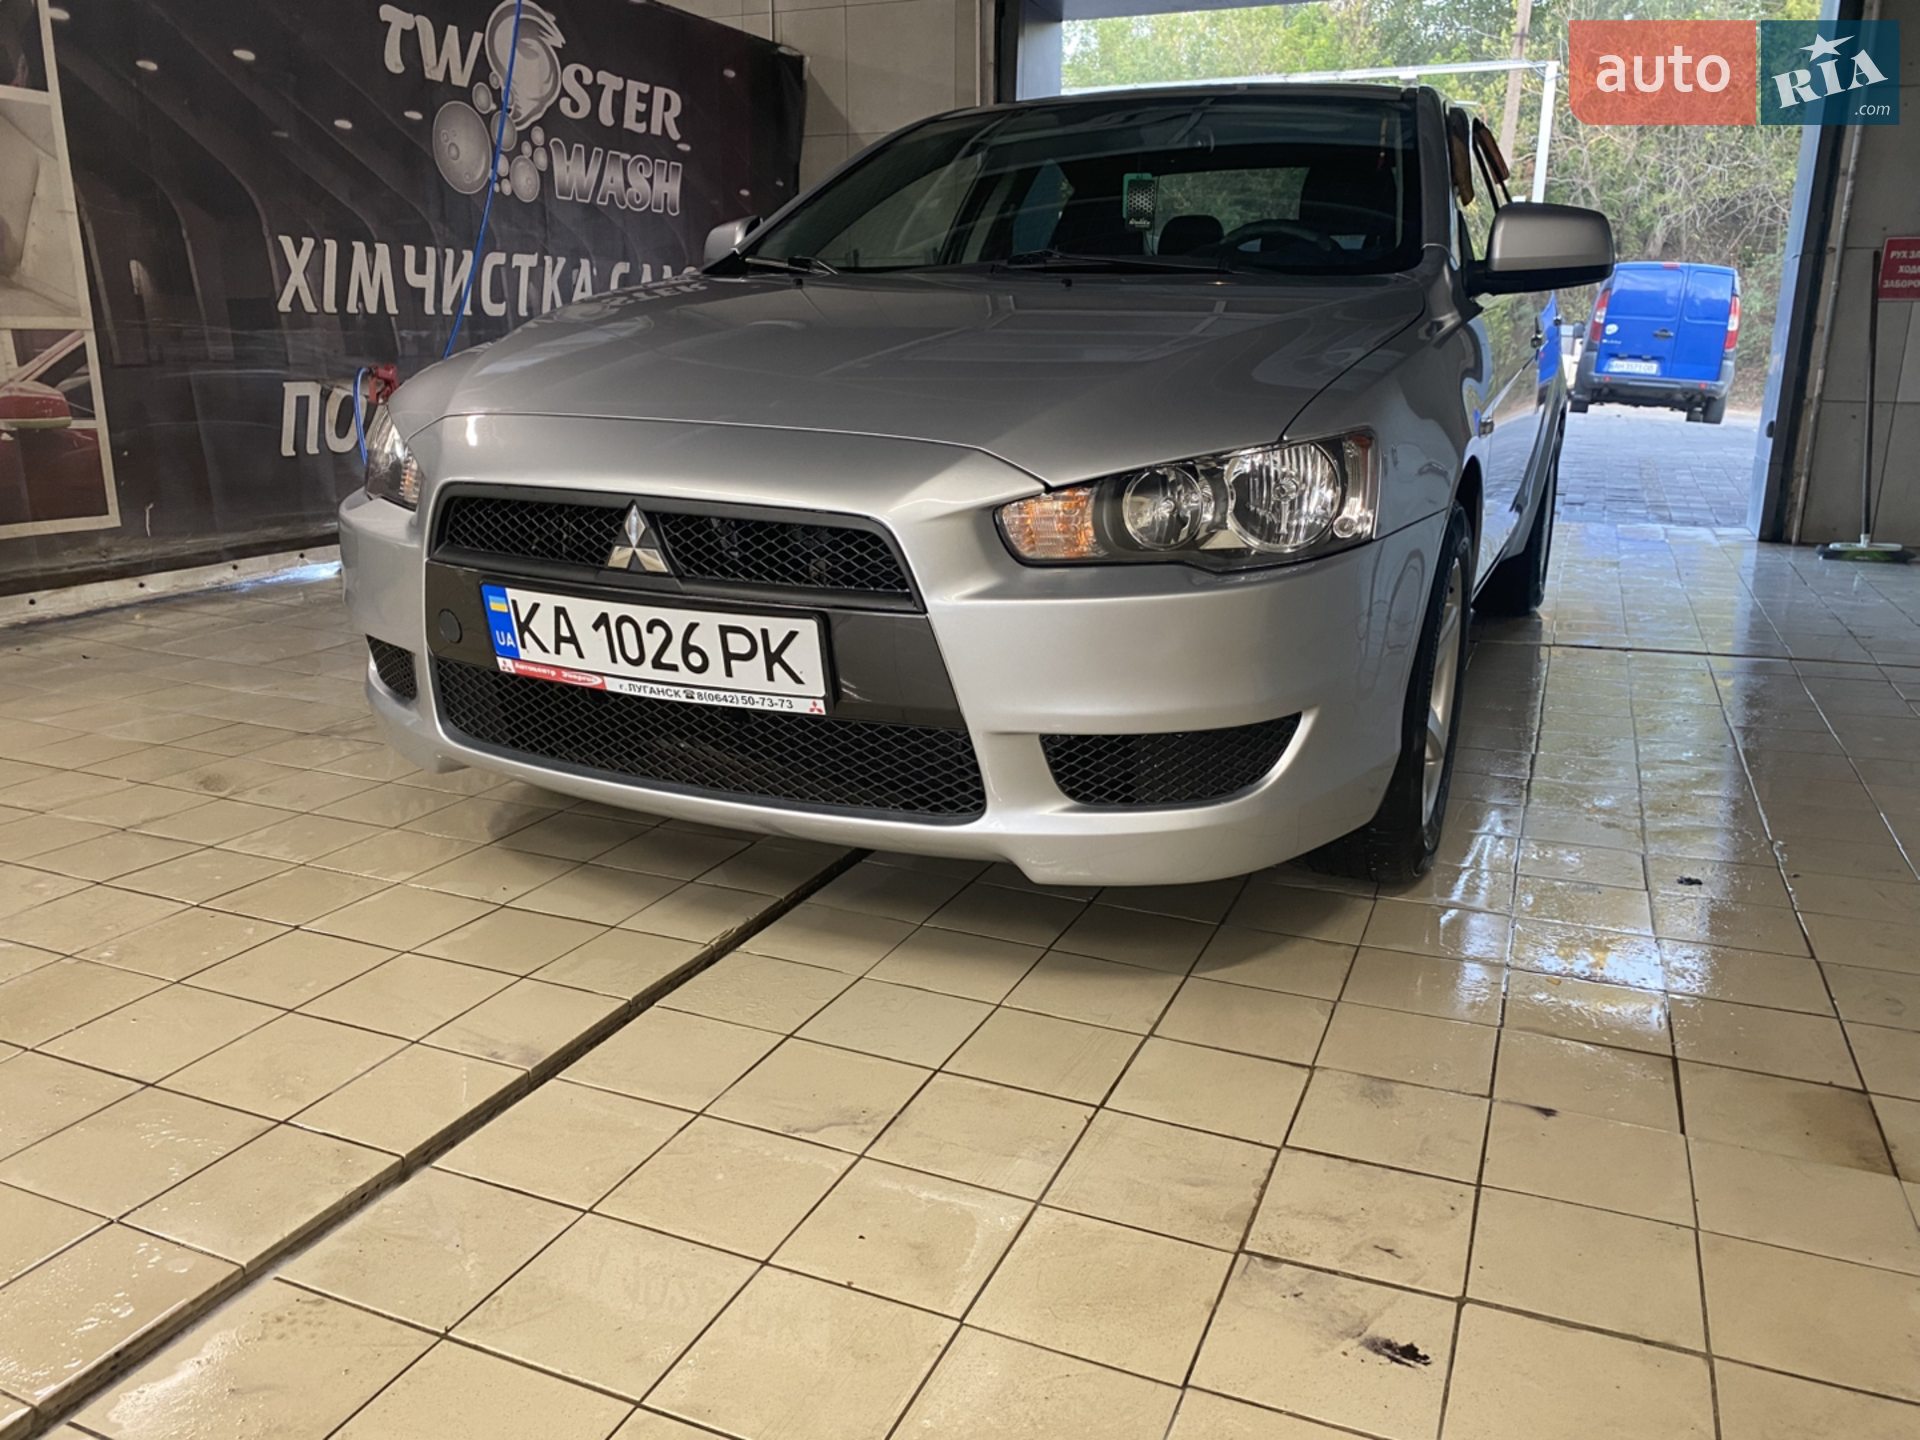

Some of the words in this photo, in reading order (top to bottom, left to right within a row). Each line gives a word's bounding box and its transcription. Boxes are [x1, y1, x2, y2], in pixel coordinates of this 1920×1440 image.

[550, 138, 683, 216] WASH
[277, 235, 594, 317] ХІМЧИСТКА
[1882, 279, 1920, 289] ЗАБОРО
[281, 382, 368, 456] ПО
[496, 630, 516, 647] UA
[510, 599, 585, 660] KA
[592, 611, 710, 675] 1026
[718, 624, 806, 686] PK
